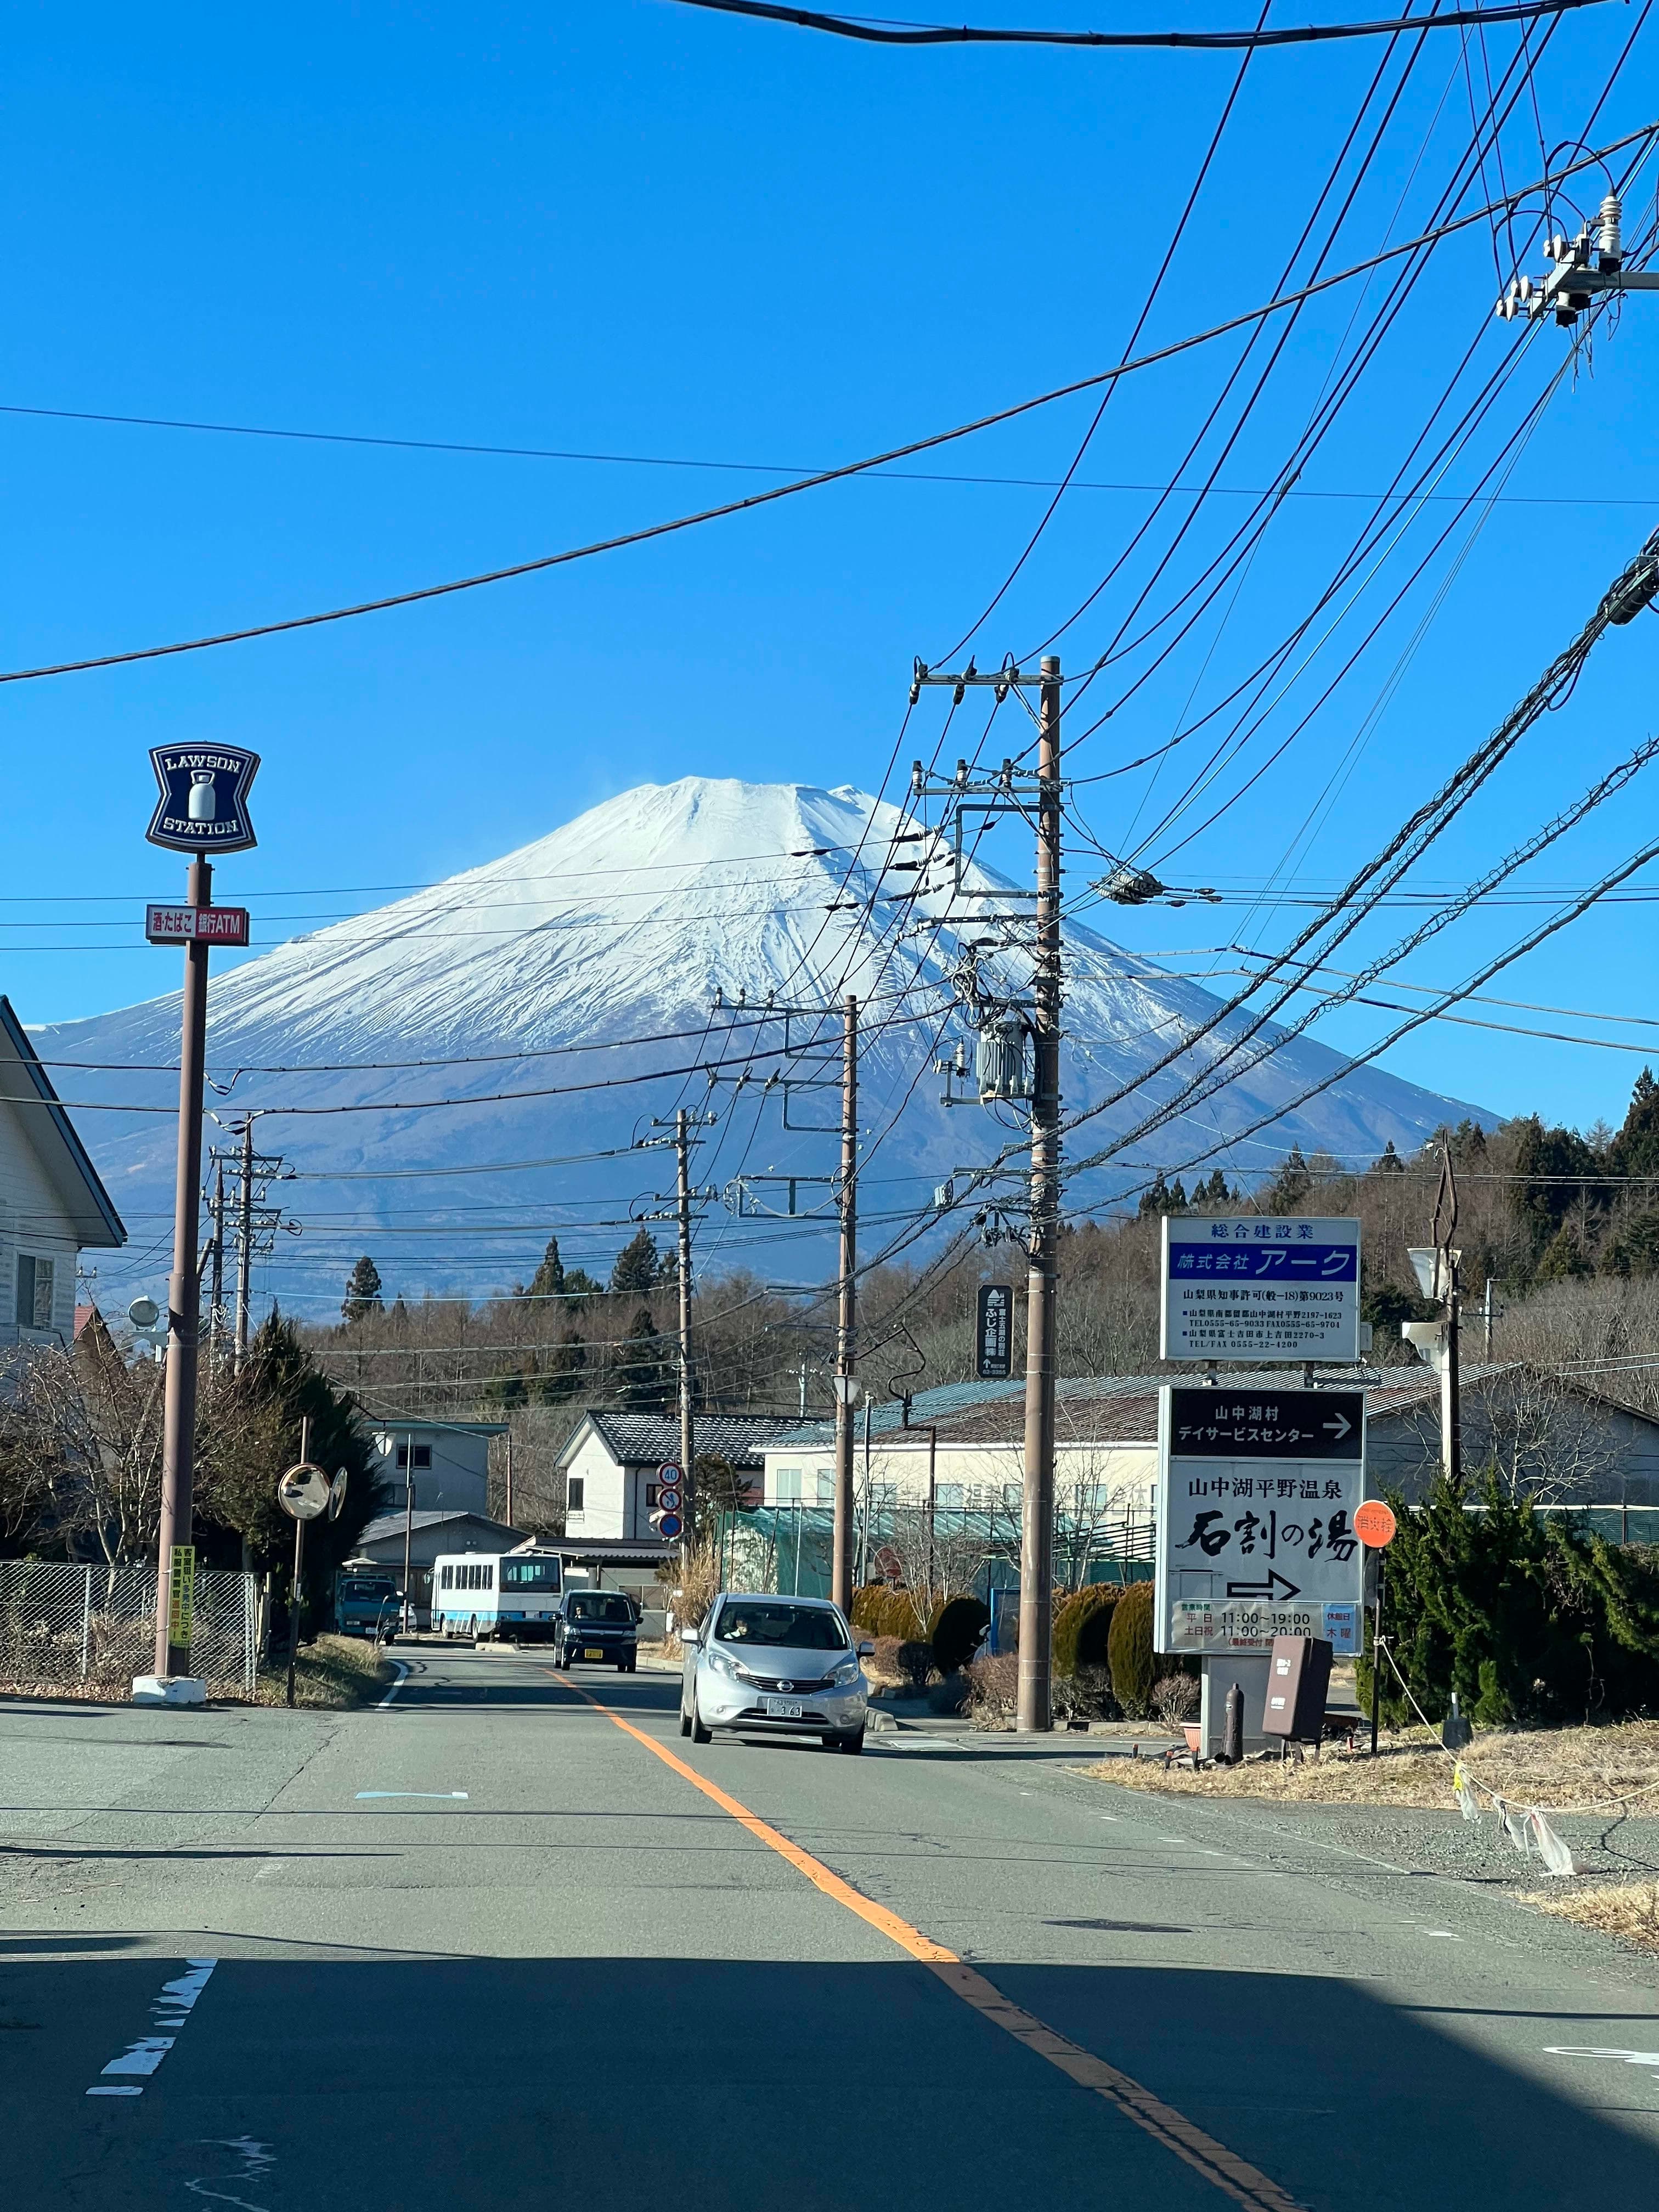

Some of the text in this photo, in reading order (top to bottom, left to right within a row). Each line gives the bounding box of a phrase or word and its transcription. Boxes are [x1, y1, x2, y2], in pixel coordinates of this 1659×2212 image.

[165, 755, 242, 774] LAWSON
[163, 817, 239, 835] STATION
[198, 913, 240, 934] 銀行ATM
[1211, 1223, 1314, 1239] 総合建設業
[1189, 1330, 1324, 1339] 山梨県富士吉田市上吉田2270-3
[1215, 1405, 1279, 1421] 山中湖村
[1179, 1426, 1314, 1442] デイサービスセンター
[664, 1469, 677, 1480] 40
[1188, 1476, 1343, 1499] 山中湖平野温泉
[1357, 1515, 1393, 1533] 消火栓
[1175, 1510, 1358, 1562] 石割の湯
[1184, 1626, 1214, 1636] 土日祝
